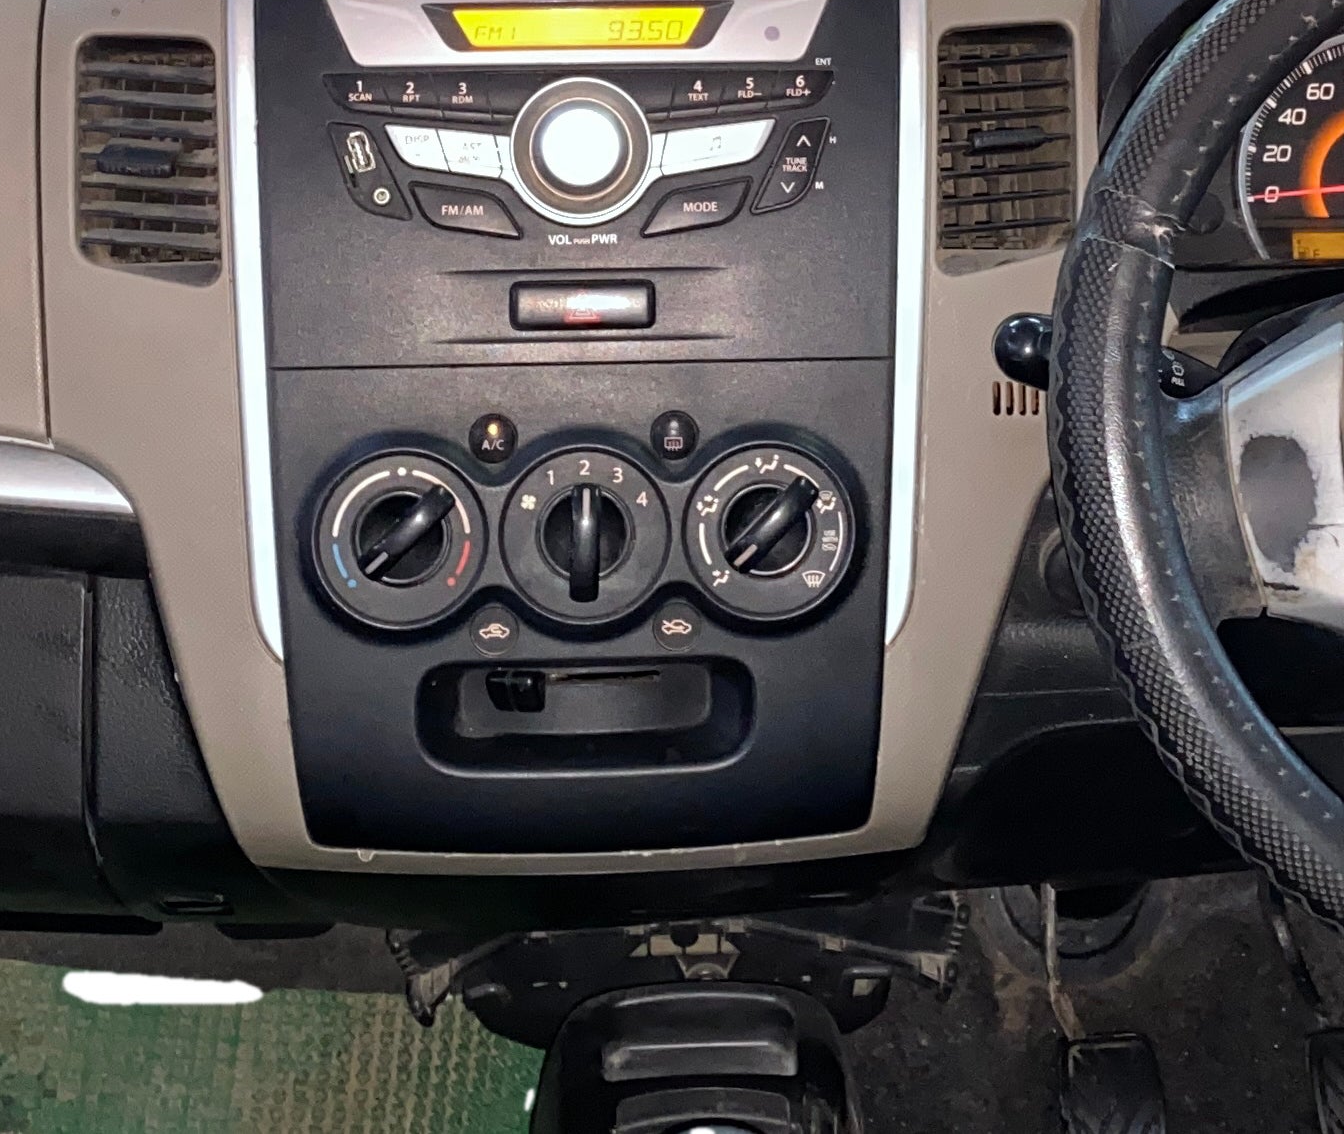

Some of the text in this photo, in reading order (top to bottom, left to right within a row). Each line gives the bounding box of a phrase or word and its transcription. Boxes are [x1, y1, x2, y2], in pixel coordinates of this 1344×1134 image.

[608, 20, 684, 41] 93.50
[815, 58, 832, 66] ENT
[356, 80, 363, 92] 1
[693, 80, 703, 92] 4
[745, 77, 755, 90] 5
[795, 75, 805, 88] 6
[406, 82, 415, 94] 2
[458, 82, 467, 95] 3
[786, 88, 812, 97] FLD+
[1306, 83, 1335, 101] 60
[348, 92, 373, 102] SCAN
[402, 94, 421, 103] RPT
[452, 95, 474, 105] RDM
[688, 93, 709, 102] TEXT
[1278, 108, 1306, 126] 40
[829, 136, 837, 144] H
[1263, 145, 1292, 162] 20
[785, 157, 807, 165] TUNE
[782, 165, 807, 173] TRACK
[815, 181, 824, 190] M
[1264, 186, 1279, 203] 0
[441, 204, 484, 216] FM/AM
[683, 202, 719, 213] MODE
[548, 234, 572, 246] VOL
[591, 233, 618, 245] PWR
[481, 439, 505, 451] A/C
[579, 459, 591, 476] 2
[546, 469, 555, 486] 1
[612, 467, 624, 483] 3
[636, 491, 649, 507] 4
